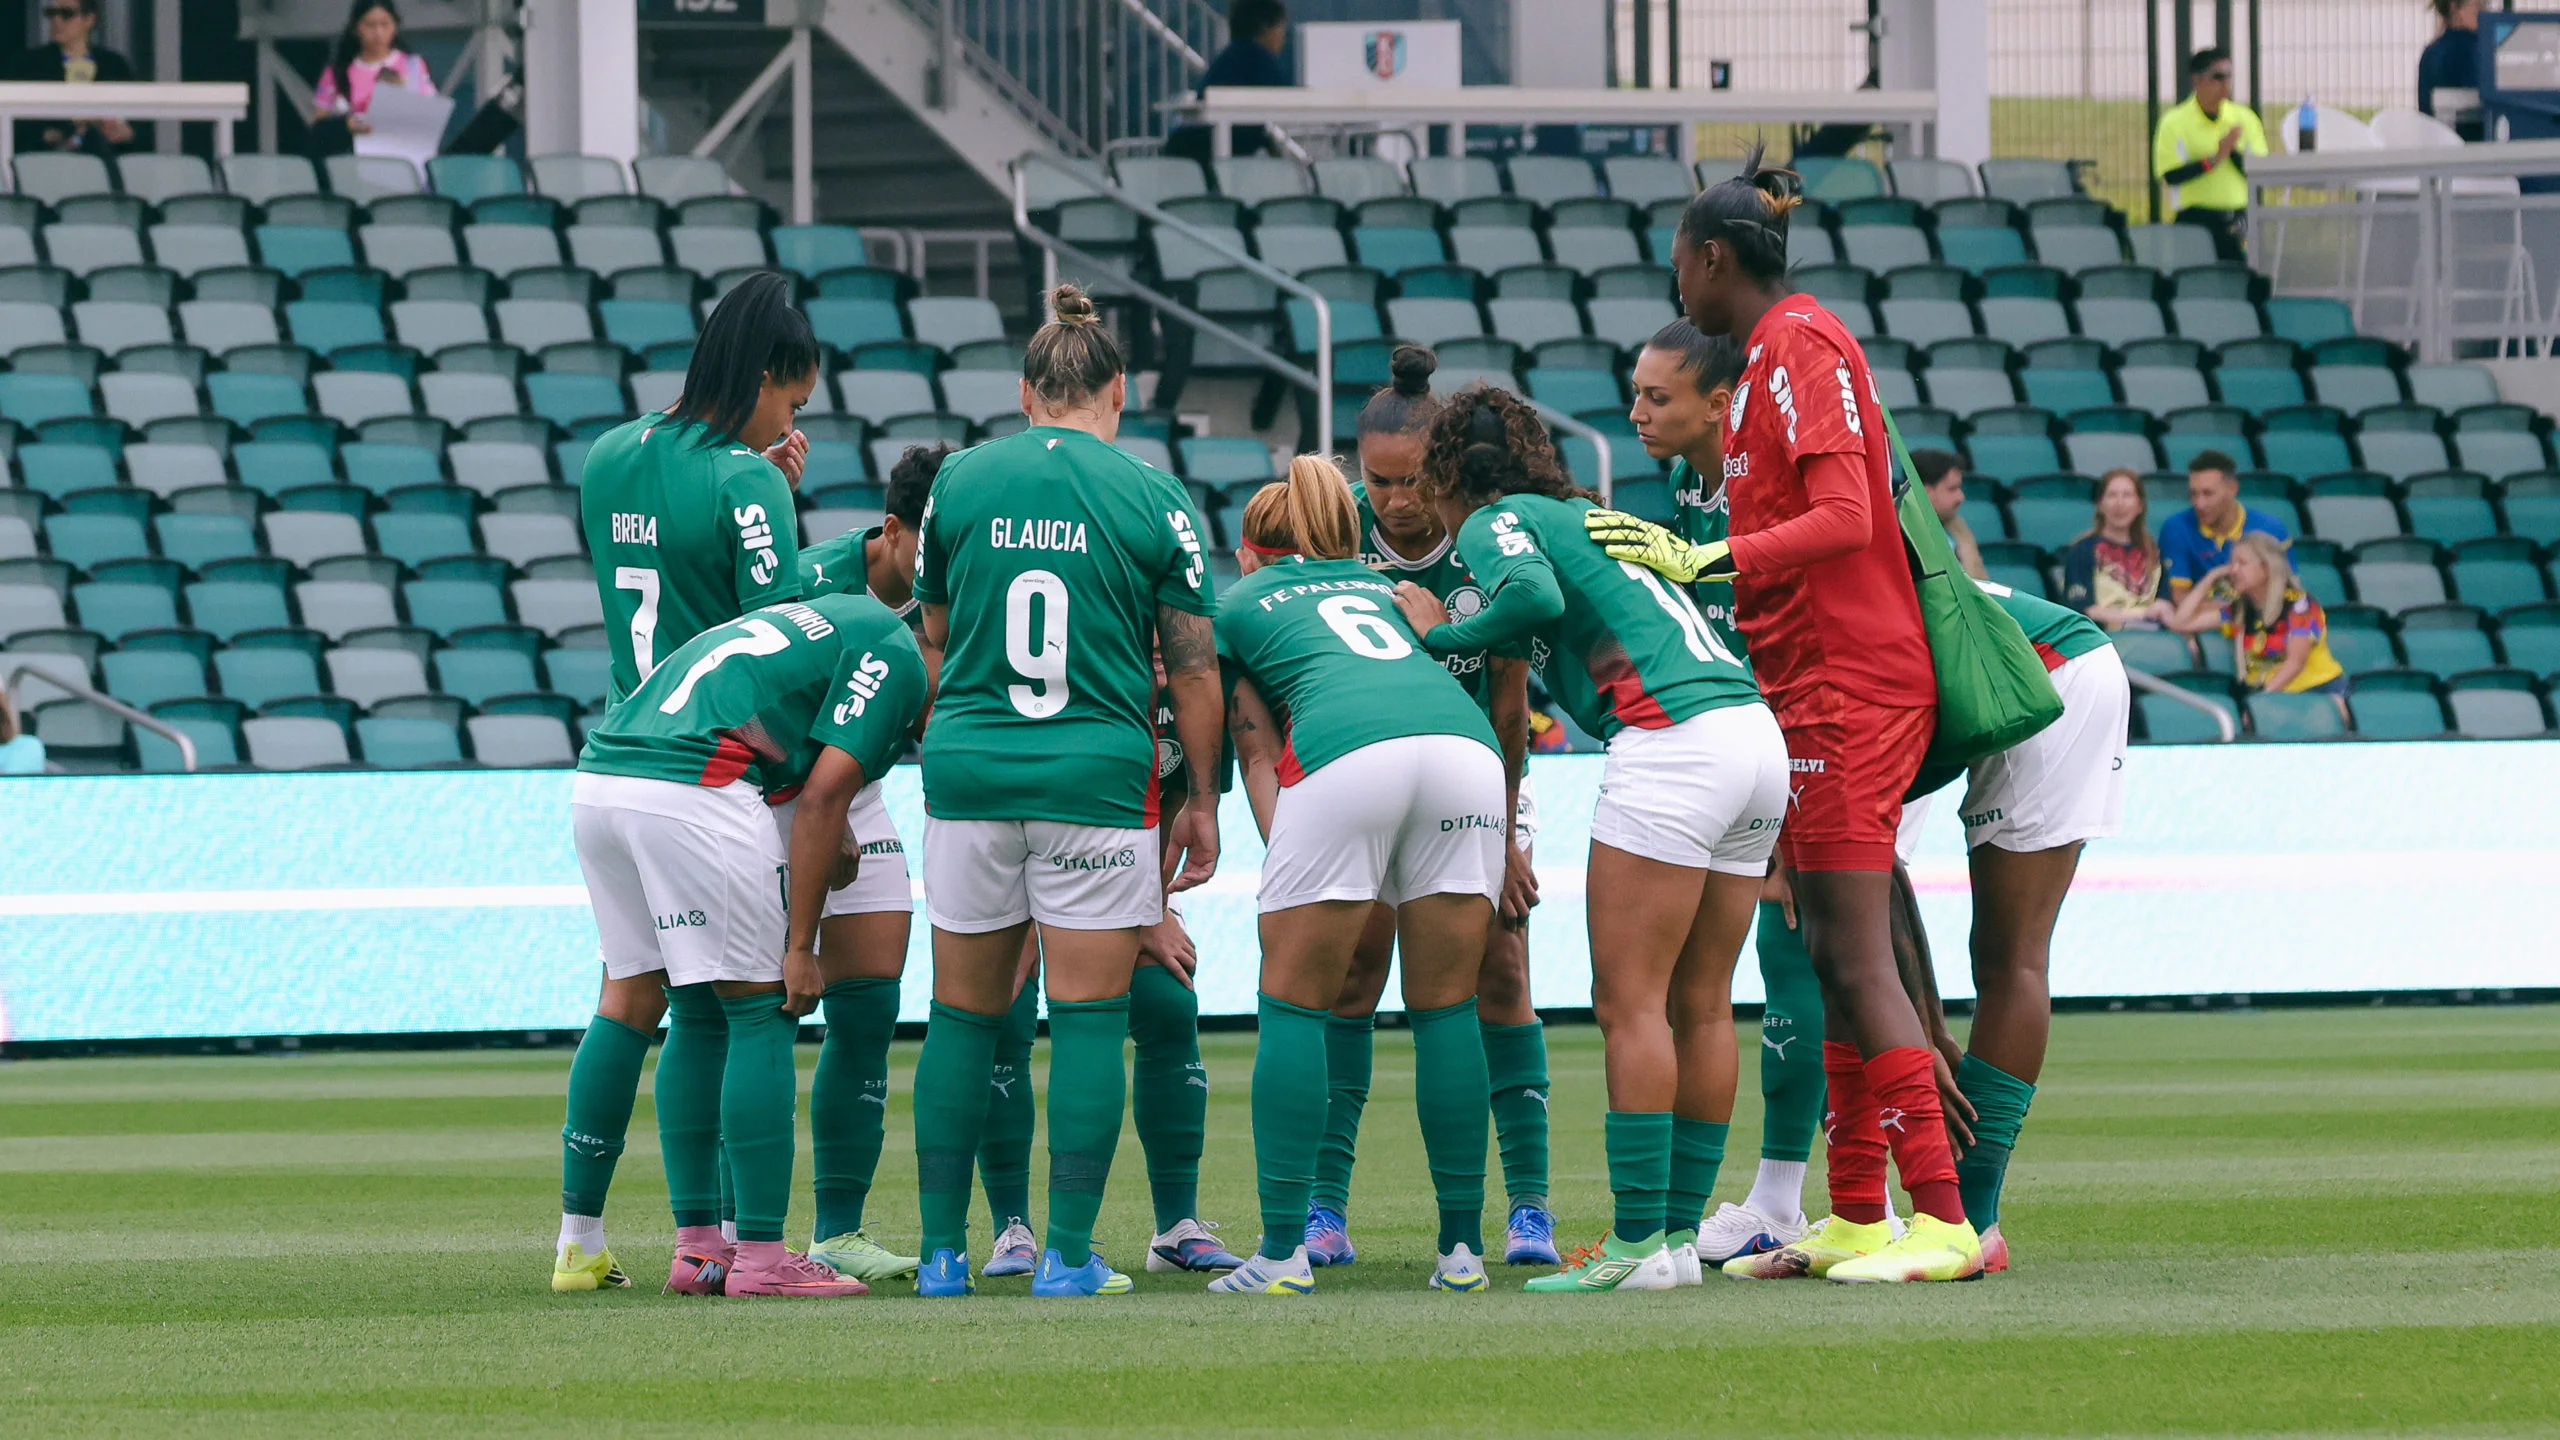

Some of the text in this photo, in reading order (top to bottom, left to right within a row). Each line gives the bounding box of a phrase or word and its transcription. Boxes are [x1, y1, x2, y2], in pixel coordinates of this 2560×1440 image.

[990, 516, 1088, 554] GLAUCIA
[614, 565, 661, 682] 7
[1258, 588, 1293, 612] FE
[1316, 594, 1414, 661] 6
[1006, 568, 1070, 719] 9
